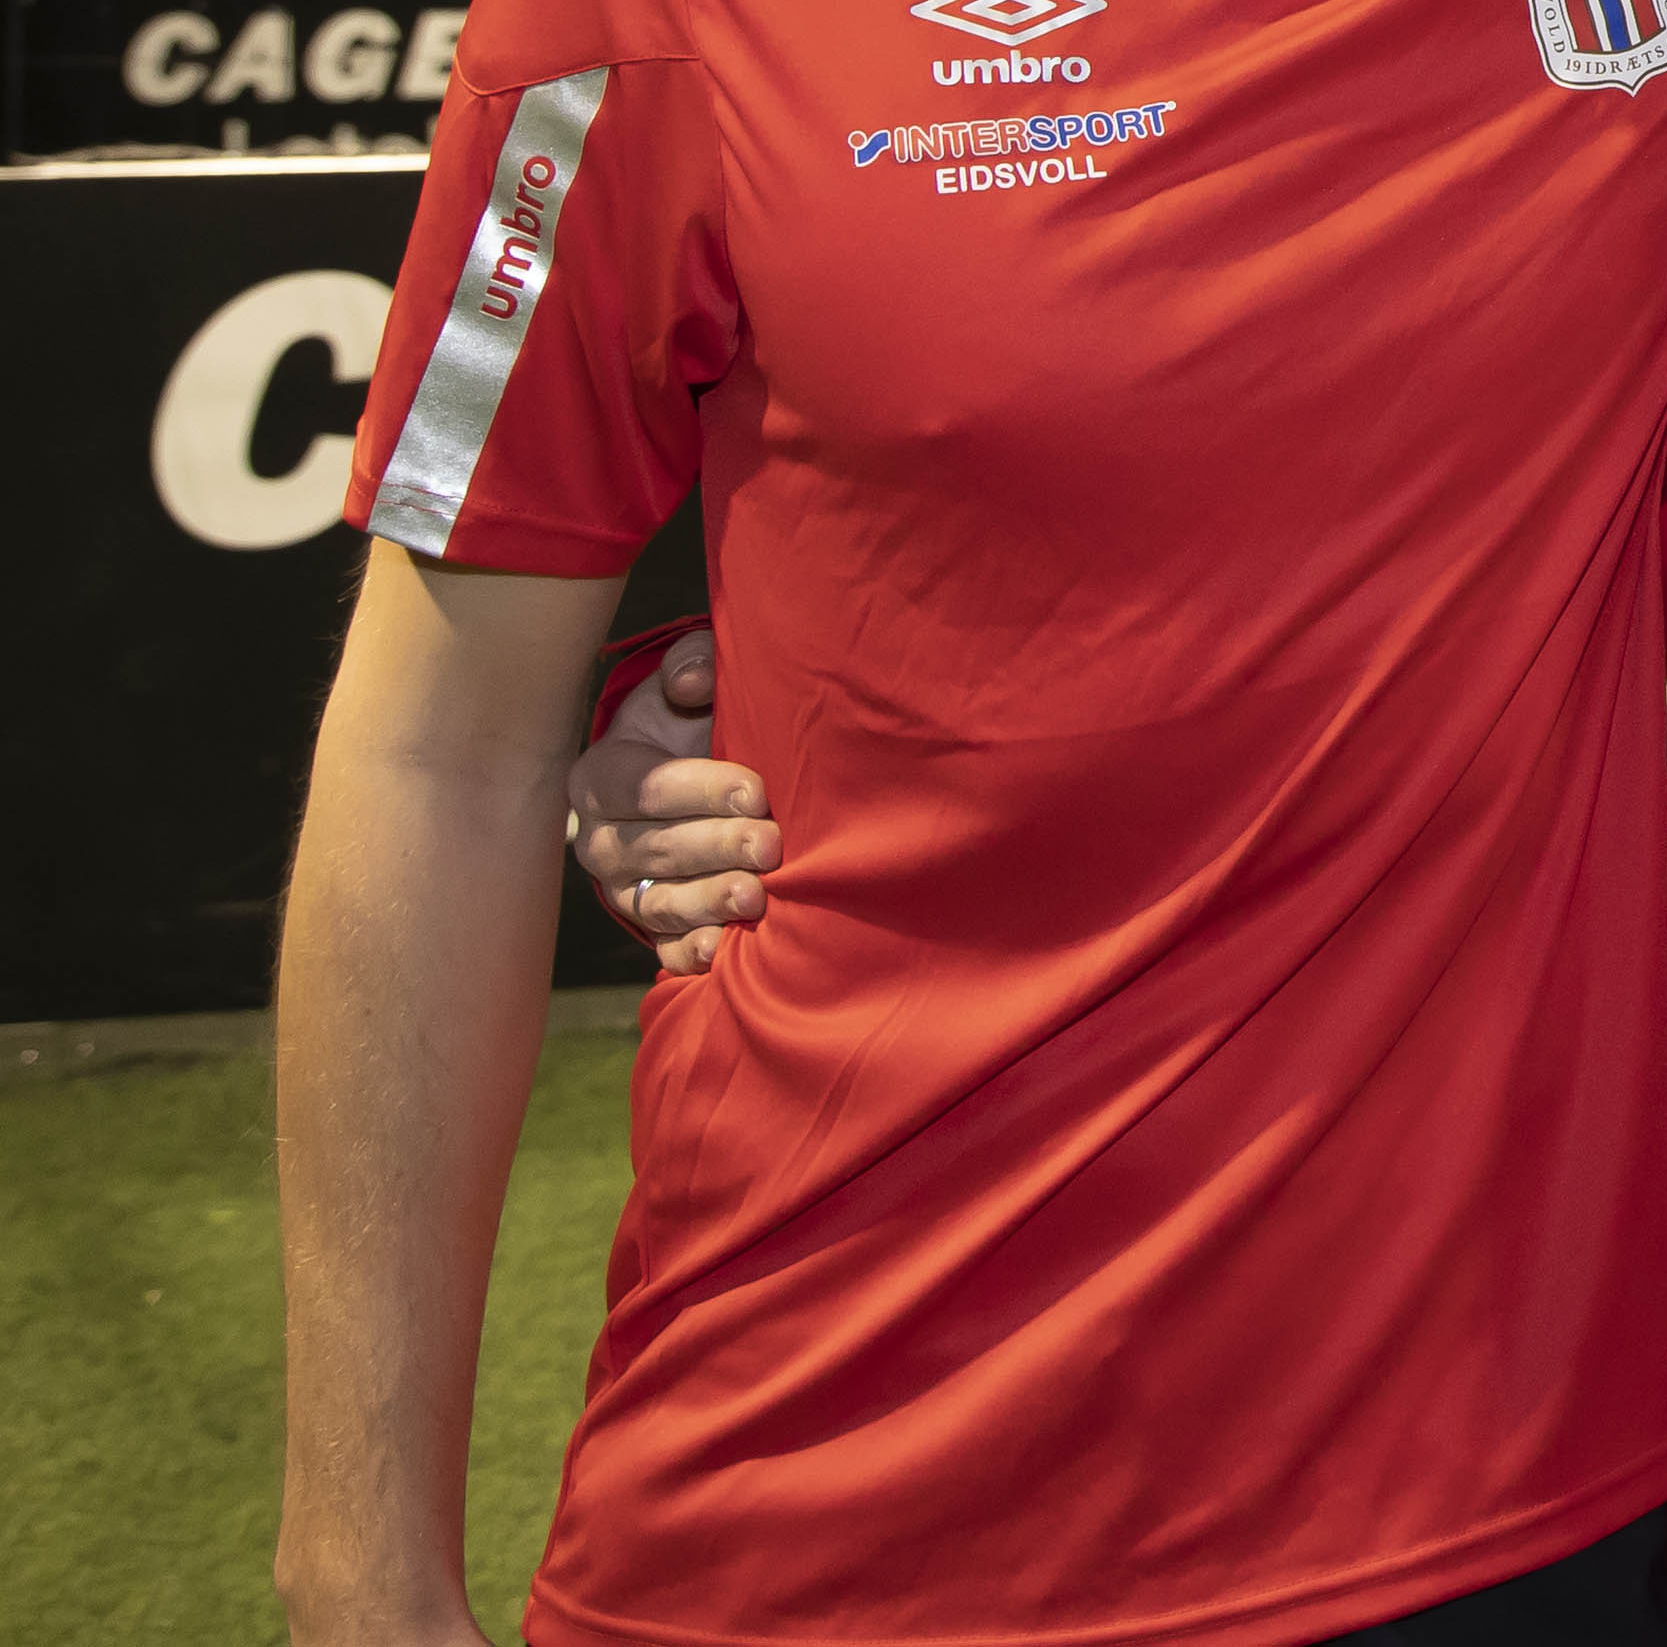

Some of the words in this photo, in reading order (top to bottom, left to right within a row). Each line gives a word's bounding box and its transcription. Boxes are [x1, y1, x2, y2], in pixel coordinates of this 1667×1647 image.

[932, 50, 1092, 86] umbro
[894, 103, 1167, 164] INTERSPORT
[935, 154, 1108, 195] EIDSVOLL
[480, 154, 557, 321] umbro
